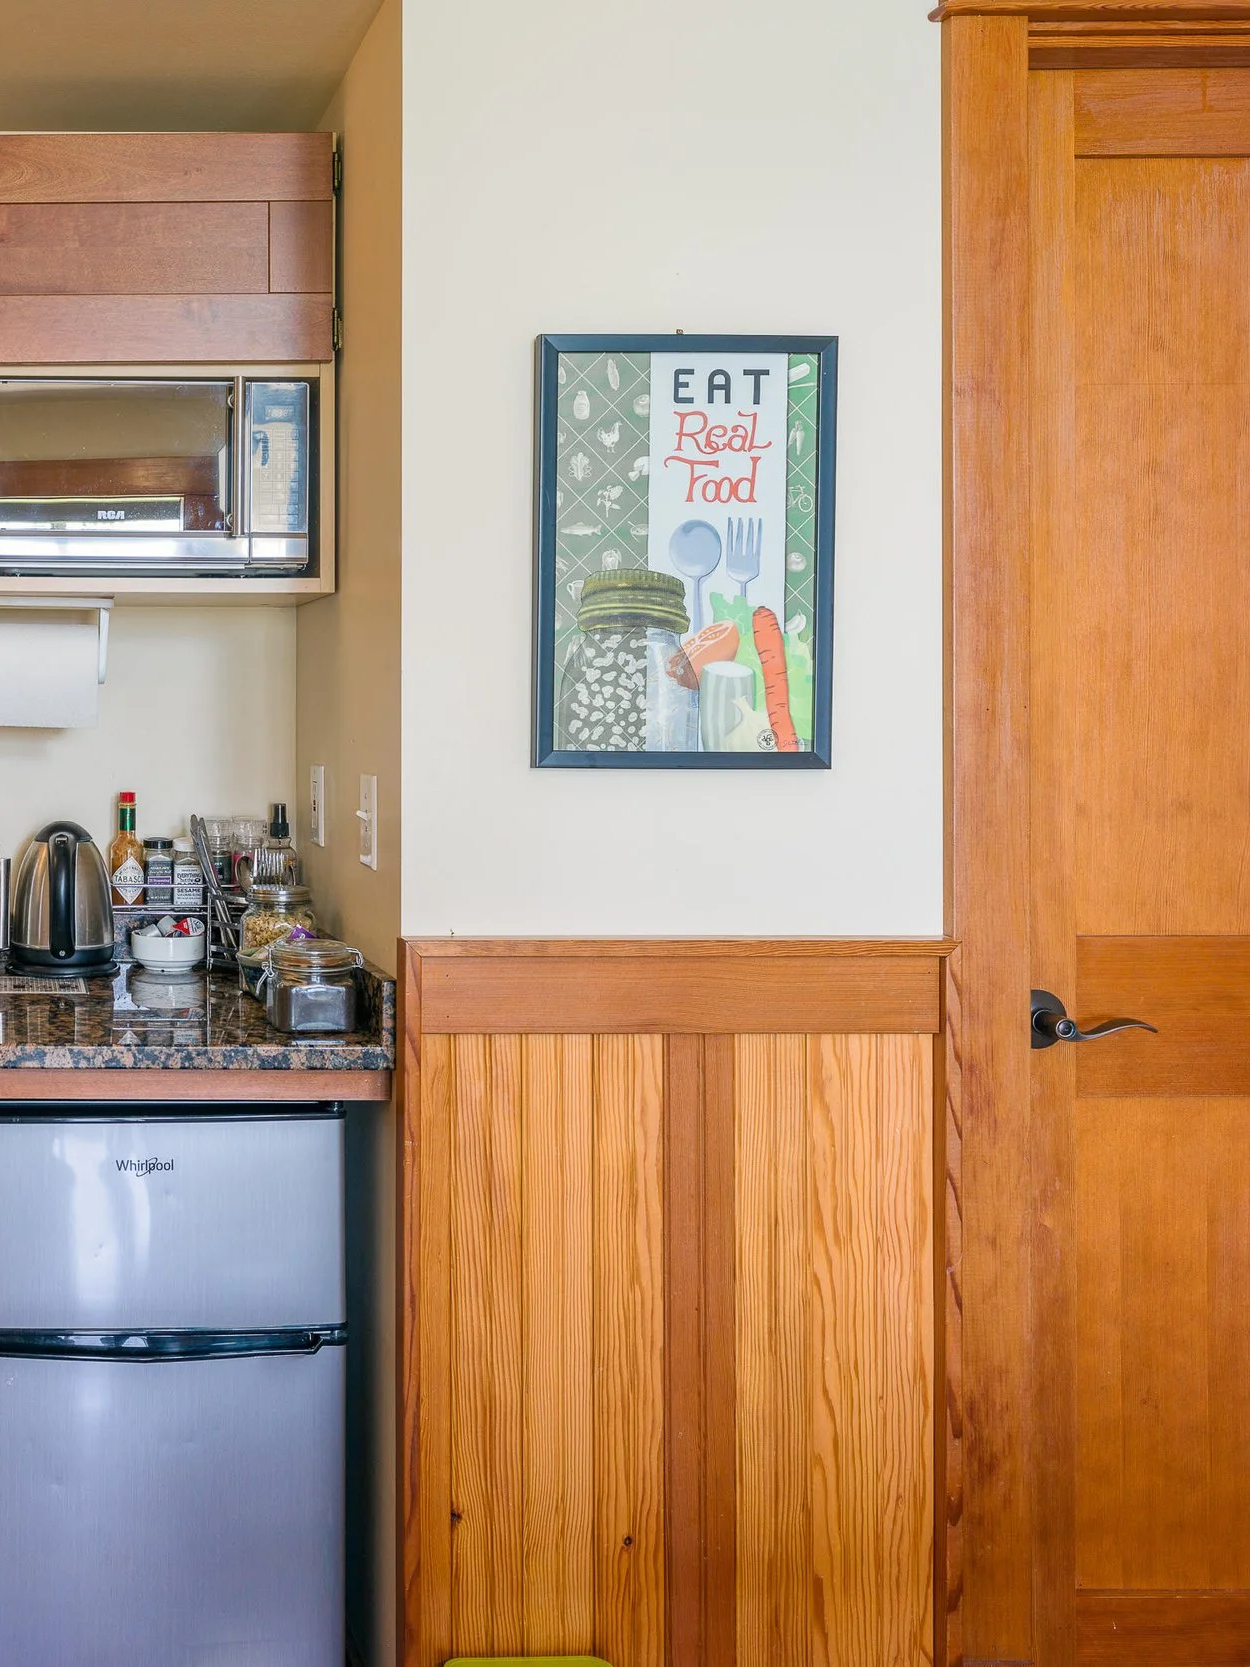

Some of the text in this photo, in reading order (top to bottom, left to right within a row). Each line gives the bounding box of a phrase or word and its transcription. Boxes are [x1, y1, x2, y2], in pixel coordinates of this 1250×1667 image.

[673, 368, 770, 405] EAT
[673, 410, 772, 455] Real
[663, 455, 761, 503] Food
[97, 510, 125, 520] RCA
[115, 1157, 174, 1177] Whirlpool
